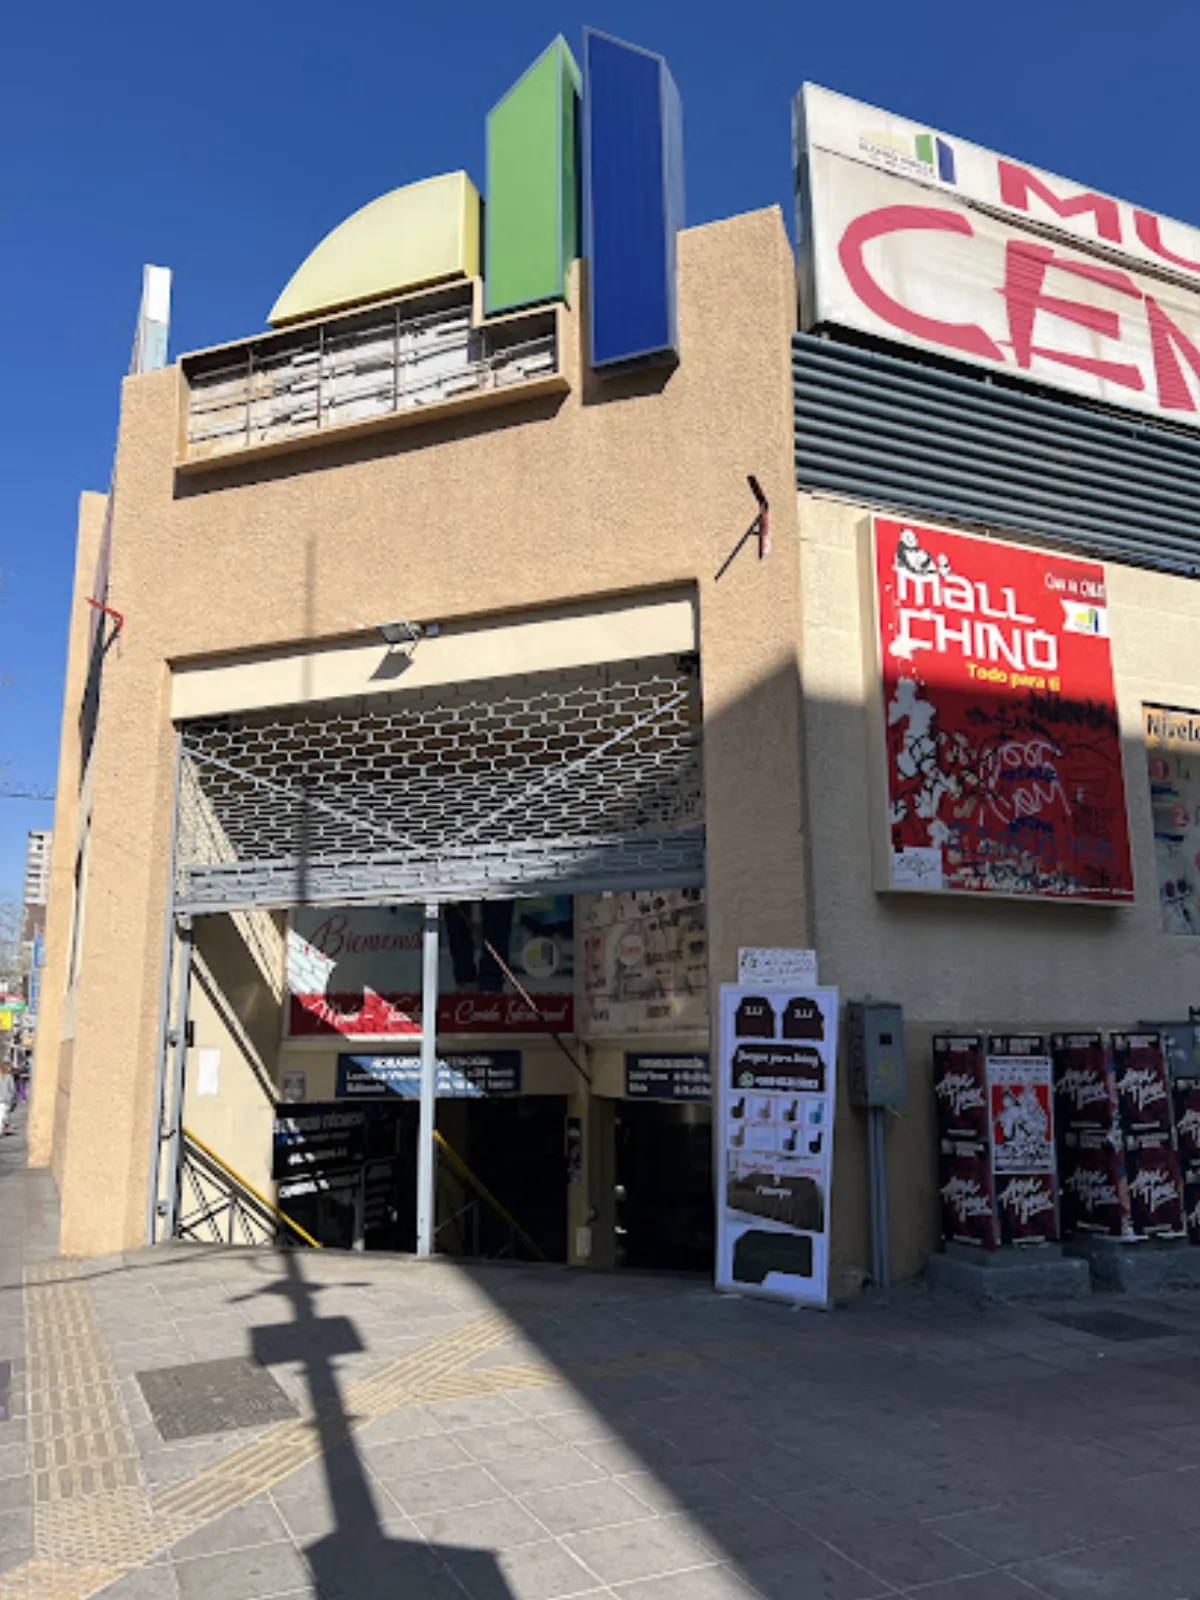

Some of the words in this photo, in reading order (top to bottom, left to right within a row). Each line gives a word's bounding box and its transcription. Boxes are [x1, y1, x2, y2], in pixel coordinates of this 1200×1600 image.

[895, 608, 1058, 672] CHINO
[967, 662, 1007, 682] Todo
[1011, 674, 1045, 689] para
